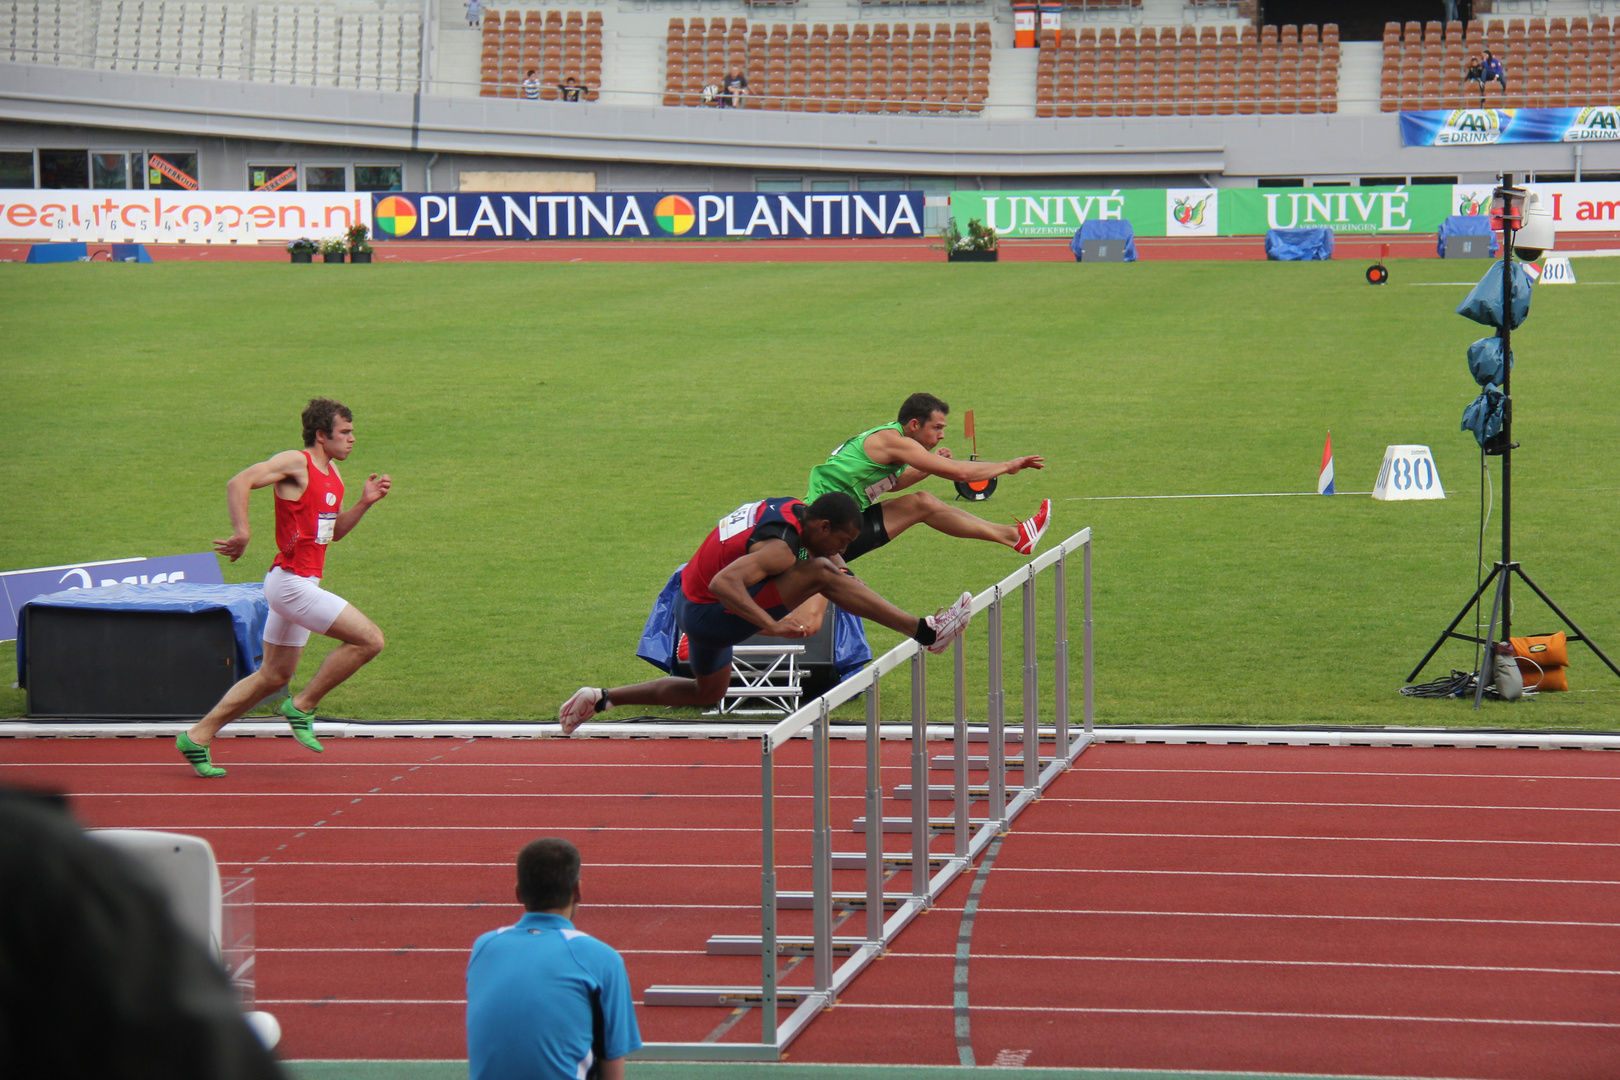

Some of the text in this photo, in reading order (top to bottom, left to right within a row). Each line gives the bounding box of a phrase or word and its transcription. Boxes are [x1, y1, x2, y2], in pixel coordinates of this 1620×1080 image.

[1459, 113, 1487, 131] AA
[1588, 111, 1617, 129] AA
[1451, 132, 1490, 142] DRINK
[1580, 130, 1619, 139] DRINK
[152, 157, 198, 190] UITVERKOOP
[0, 197, 361, 228] eautokopen.nl
[420, 195, 650, 236] PLANTINA
[698, 194, 921, 235] PLANTINA
[982, 189, 1124, 235] UNIVÉ
[1263, 185, 1412, 231] UNIVÉ
[1552, 193, 1562, 221] I
[57, 219, 64, 230] 8
[84, 219, 91, 230] 7
[110, 219, 117, 230] 6
[140, 220, 147, 231] 5
[164, 220, 171, 231] 4
[193, 221, 199, 232] 3
[217, 221, 224, 232] 2
[1543, 263, 1564, 280] 80
[1393, 457, 1434, 491] 80
